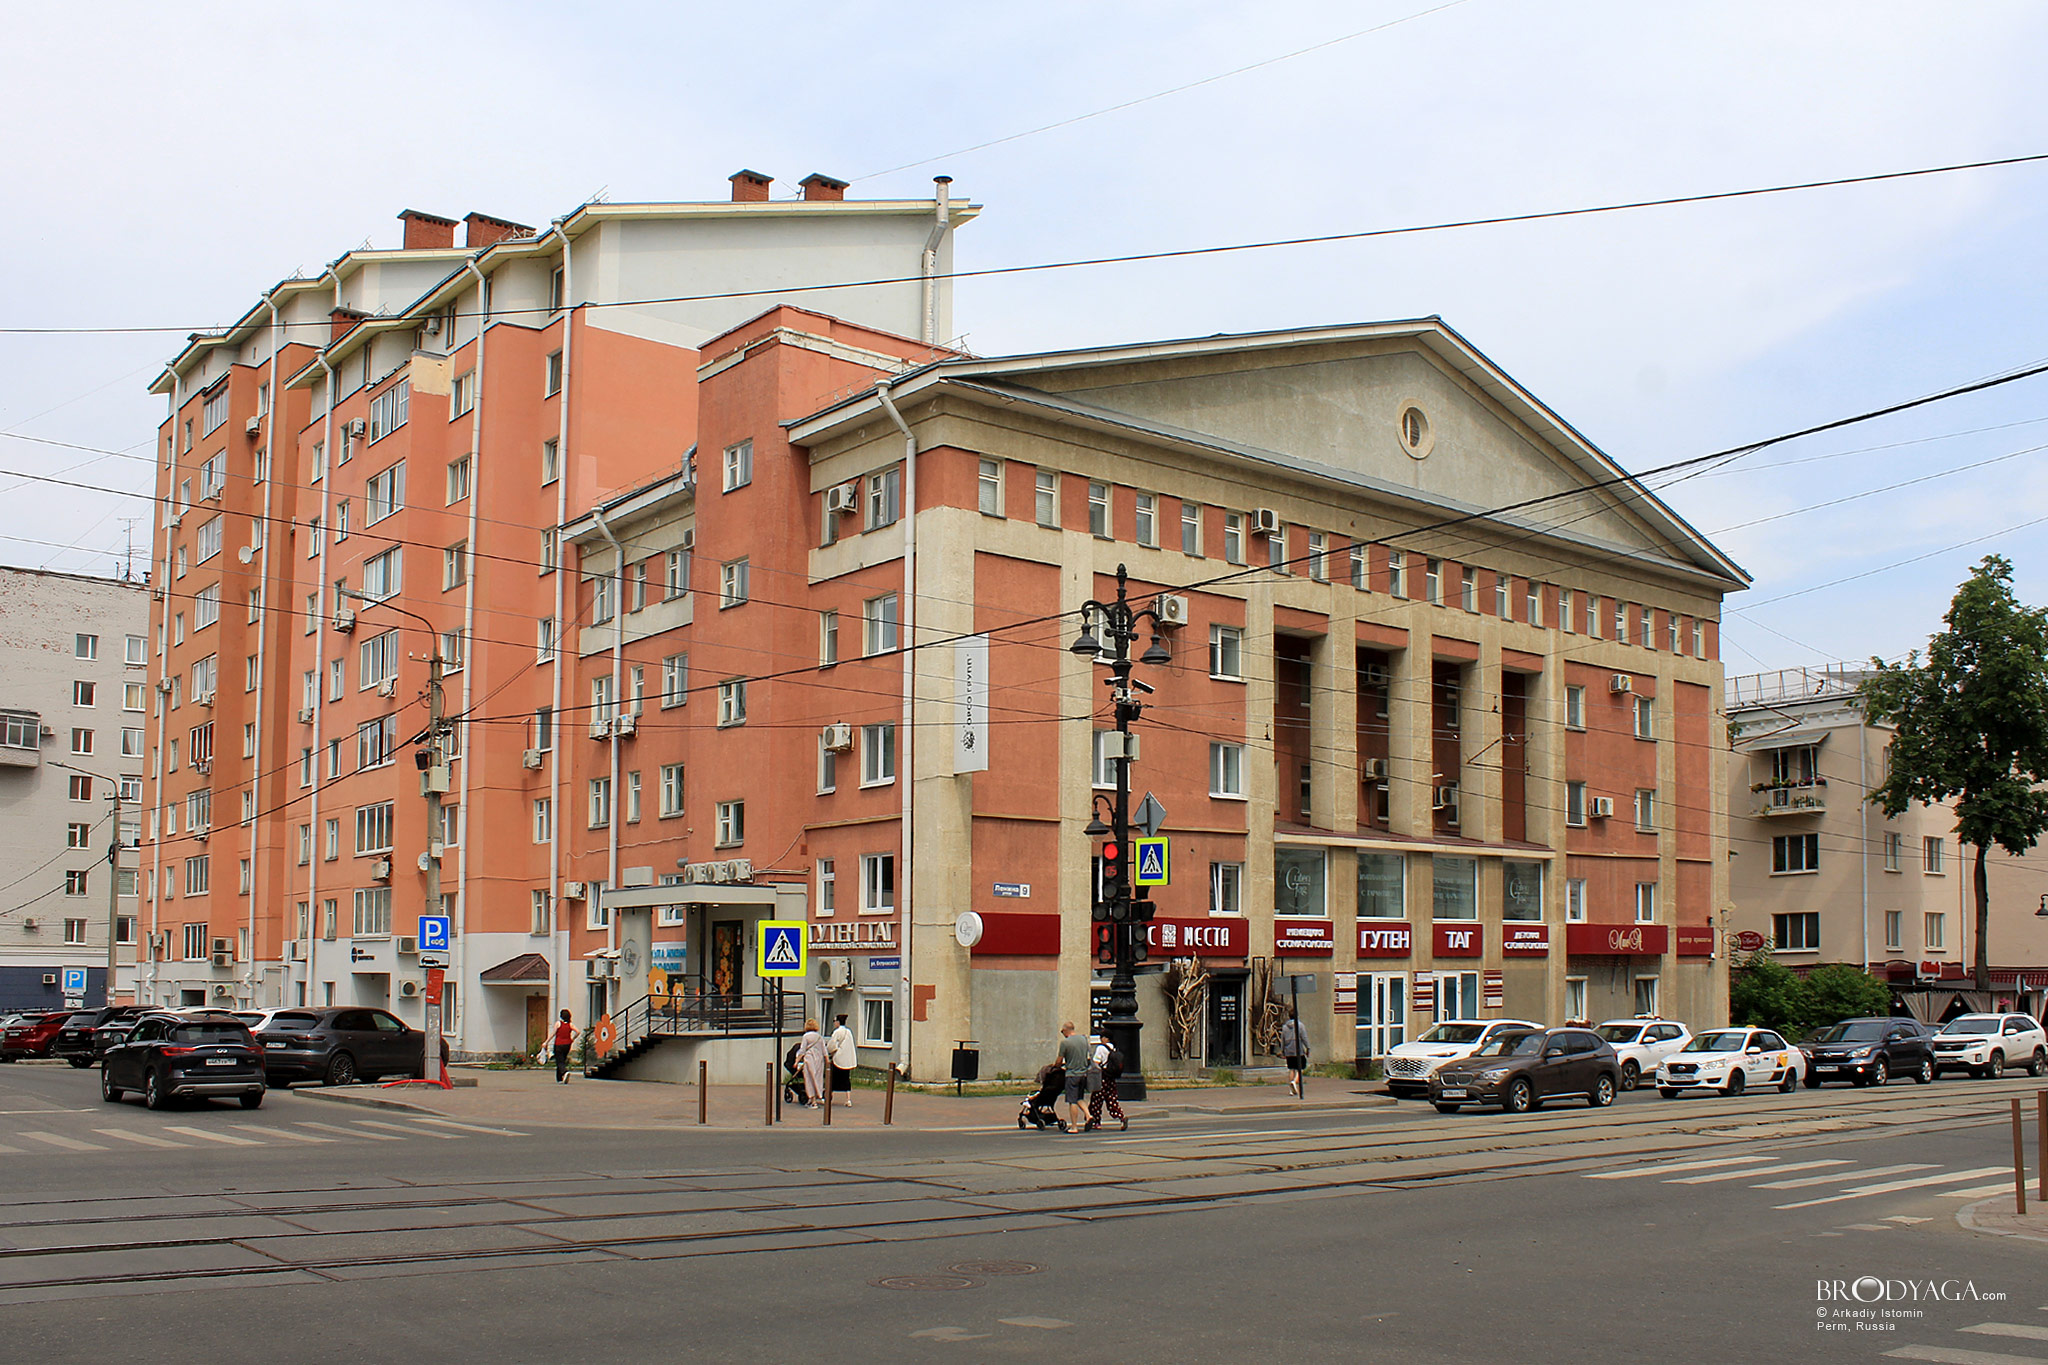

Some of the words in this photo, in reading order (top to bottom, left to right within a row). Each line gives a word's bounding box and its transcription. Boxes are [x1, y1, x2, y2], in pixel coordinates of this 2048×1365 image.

[1022, 886, 1028, 895] 9
[864, 922, 896, 941] ТАГ
[1184, 926, 1229, 946] МЕСТА
[1361, 930, 1409, 948] ГУТЕН
[1445, 931, 1473, 948] ТАГ
